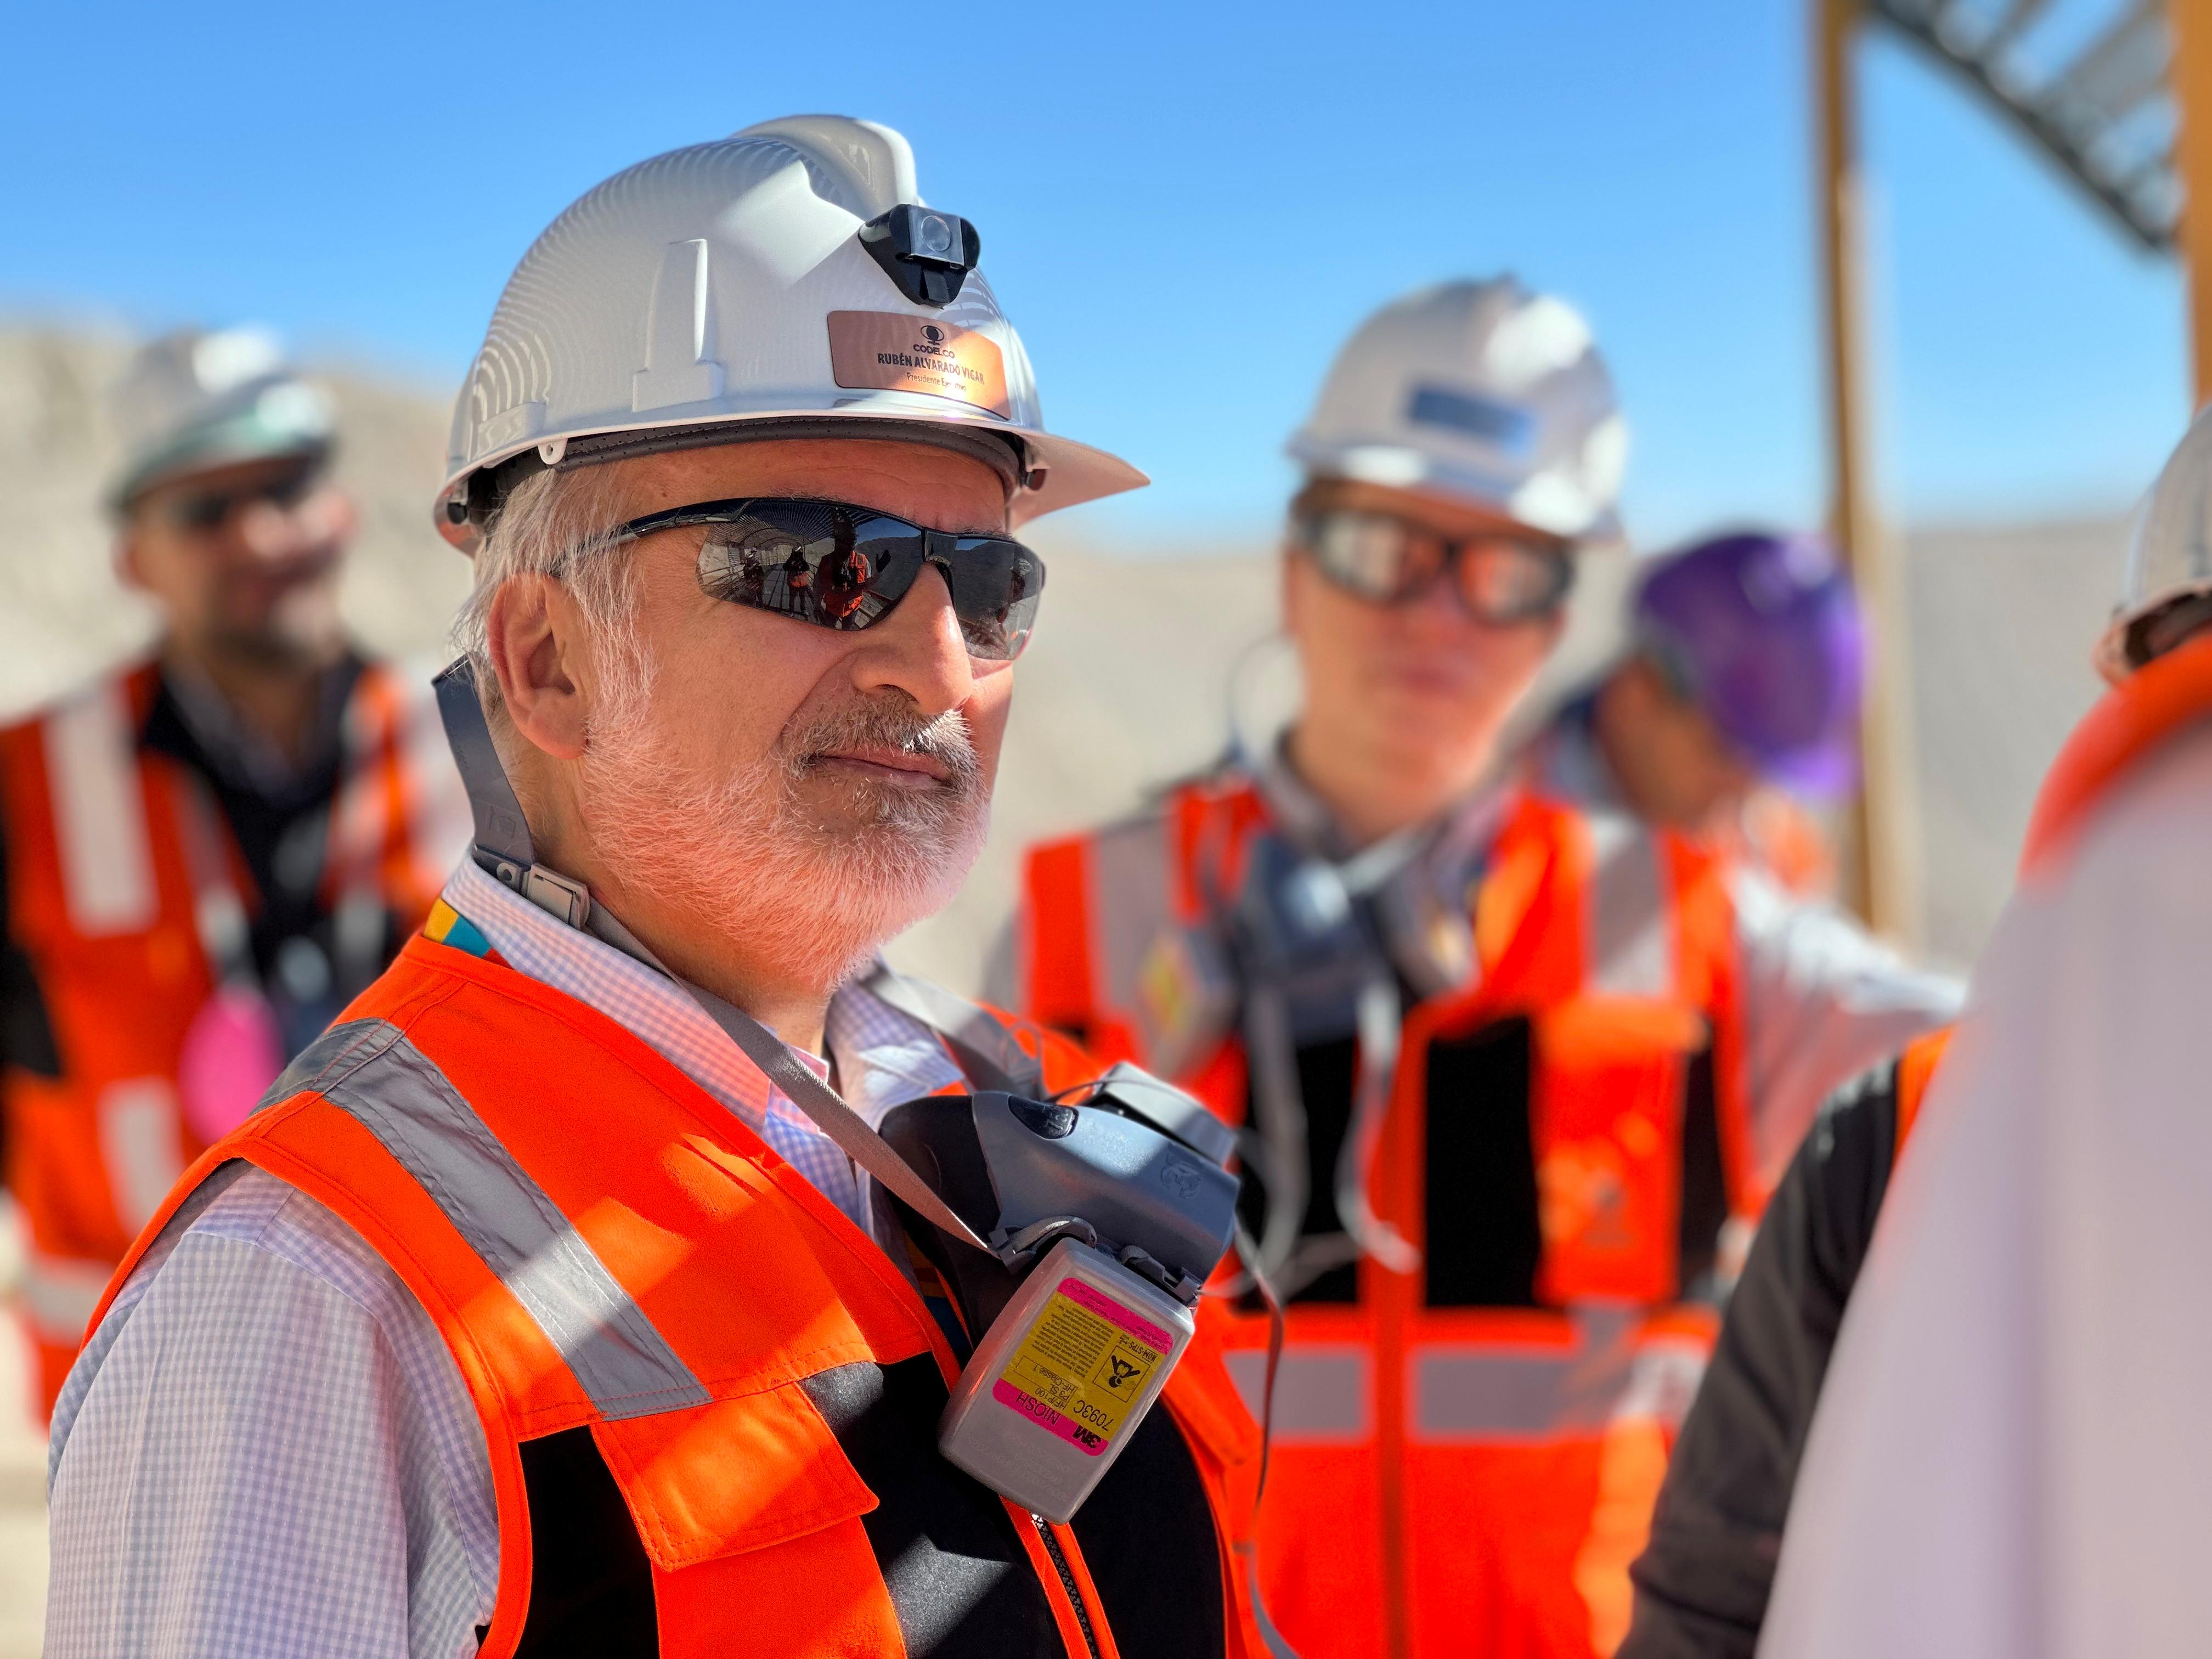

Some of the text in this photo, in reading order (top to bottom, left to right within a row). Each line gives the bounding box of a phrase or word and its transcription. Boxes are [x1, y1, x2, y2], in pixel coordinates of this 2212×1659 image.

[913, 343, 955, 358] CODELCO
[877, 352, 984, 385] RUBÉN ALVARADO VIGAR
[907, 372, 940, 385] Presidente
[1037, 1367, 1075, 1392] HF-Classe
[1047, 1383, 1070, 1401] P3 SL
[1014, 1390, 1060, 1426] NIOSH
[1034, 1386, 1067, 1410] HF/P100
[1071, 1398, 1114, 1432] 7093C
[1071, 1424, 1103, 1449] 3M
